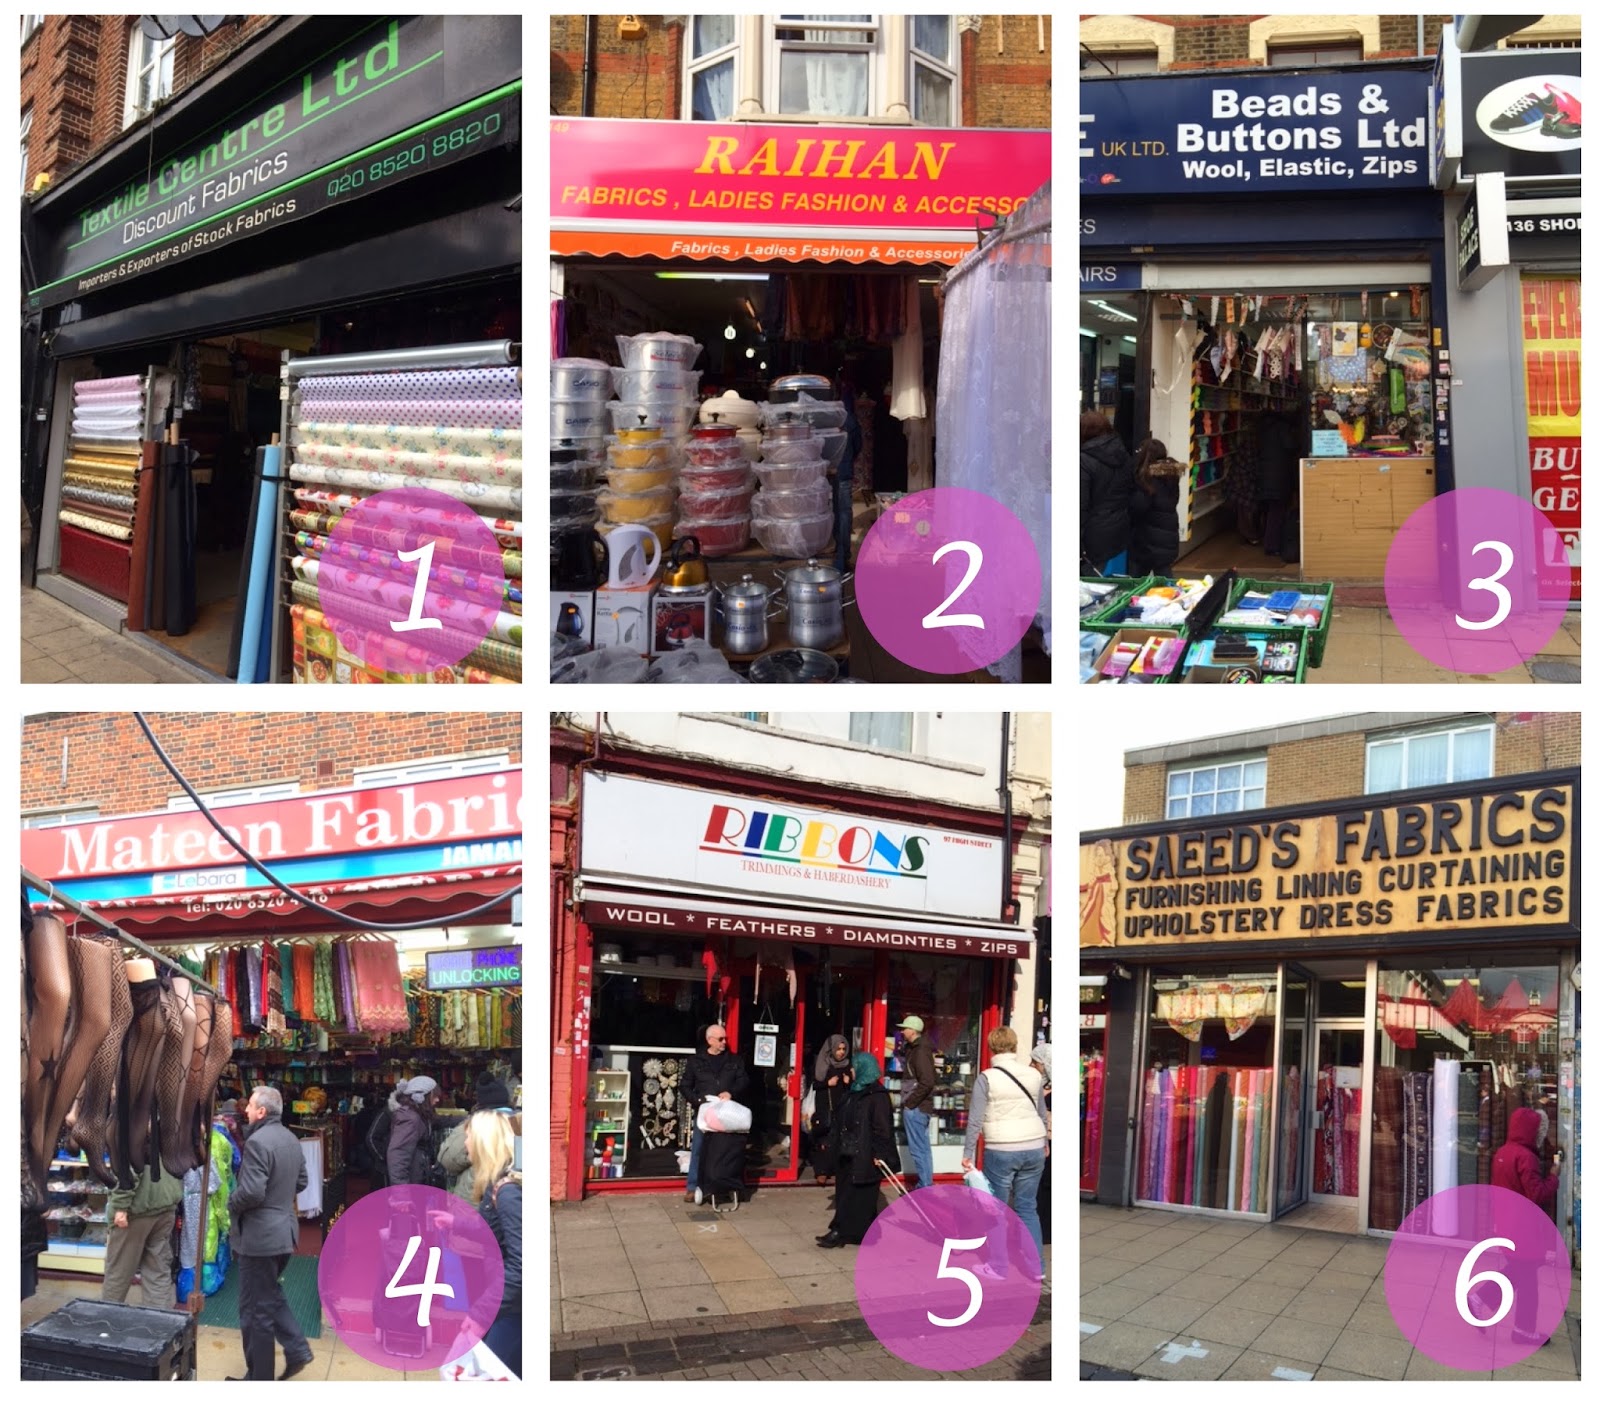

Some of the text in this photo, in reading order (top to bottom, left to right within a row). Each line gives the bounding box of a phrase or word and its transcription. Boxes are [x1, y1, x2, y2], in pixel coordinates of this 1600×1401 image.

[1212, 84, 1390, 119] Beads &
[80, 20, 398, 237] Textile Centre Ltd
[1102, 141, 1127, 157] UK
[1132, 141, 1170, 157] LTD.
[1177, 117, 1426, 152] Buttons Ltd
[327, 113, 500, 196] 020 8520 8820
[694, 136, 956, 180] RAIHAN
[1182, 156, 1418, 181] Wool, Elastic, Zips
[123, 151, 288, 244] Discount Fabrics
[688, 189, 774, 209] LADIES
[781, 191, 886, 213] FASHION
[892, 194, 908, 213] &
[78, 199, 297, 291] Importers & Exporters of Stock Fabrics
[744, 243, 797, 256] Ladies
[801, 244, 864, 257] Fashion
[868, 245, 881, 258] &
[58, 775, 522, 876] Mateen Fabri
[703, 804, 930, 872] RIBBONS
[1125, 788, 1566, 881] SAEED'S FABRICS
[177, 872, 237, 888] Lebara
[741, 860, 891, 889] TRIMMINGS & HABERDASHERY
[1125, 849, 1565, 910] FURNISHING LINING CURTAINING
[606, 907, 1018, 955] WOOL FEATHERS DIAMONTIES ZIPS
[1124, 886, 1564, 938] UPHOLSTERY DRESS FABRICS
[432, 966, 520, 985] UNLOCKING
